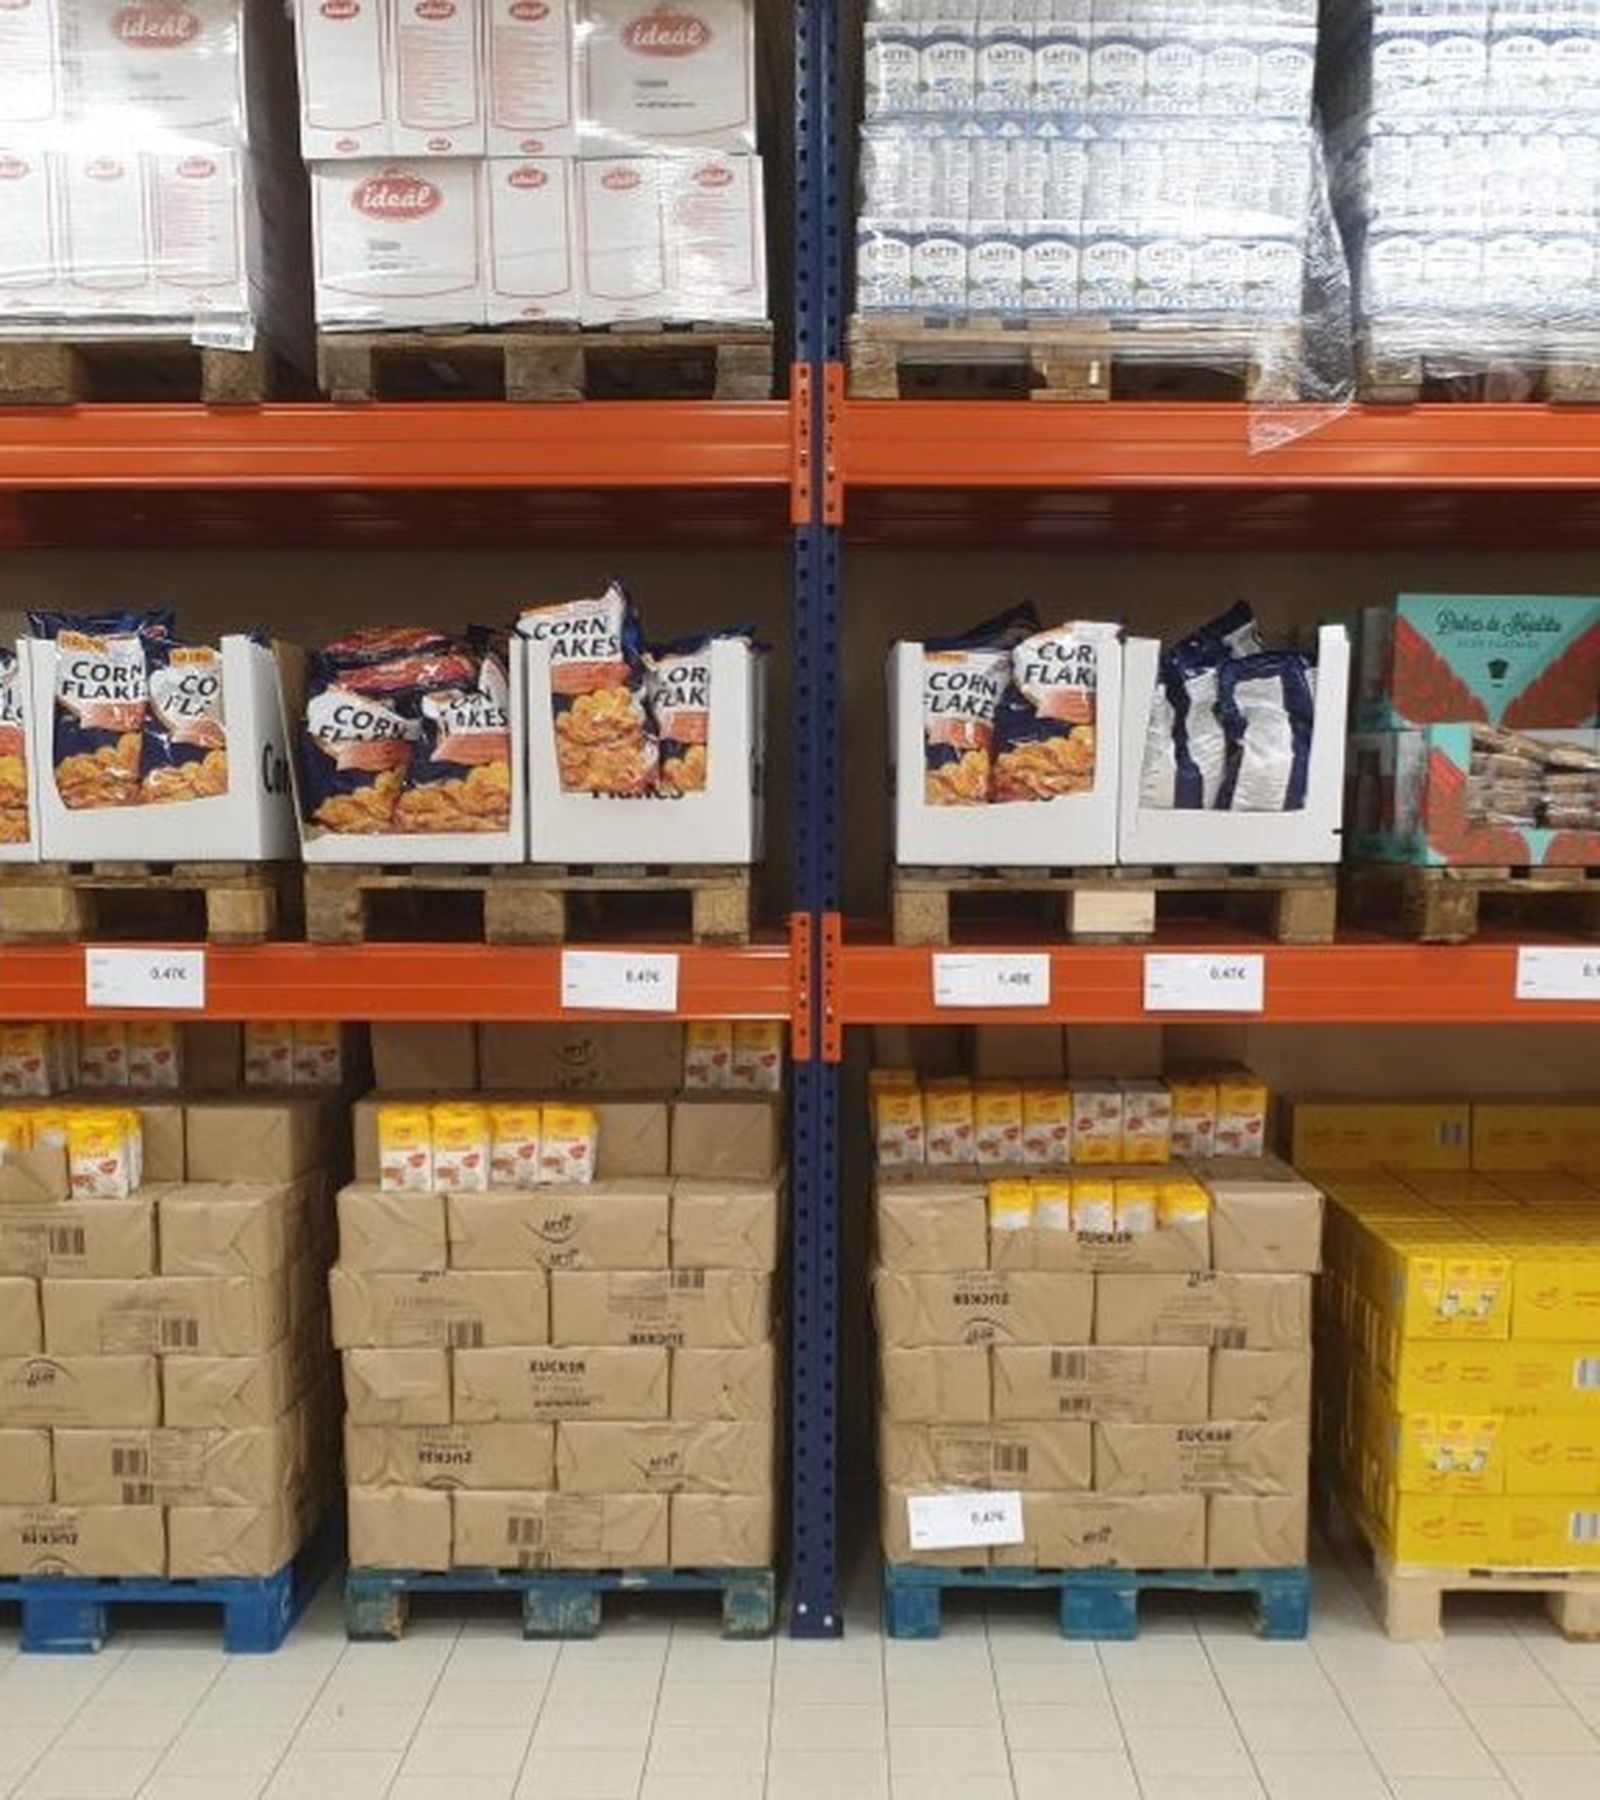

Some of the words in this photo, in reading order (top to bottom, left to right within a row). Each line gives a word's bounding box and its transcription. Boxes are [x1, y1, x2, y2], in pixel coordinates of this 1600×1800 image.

[534, 617, 608, 640] CORN
[71, 661, 142, 680] CORN
[929, 672, 998, 696] CORN
